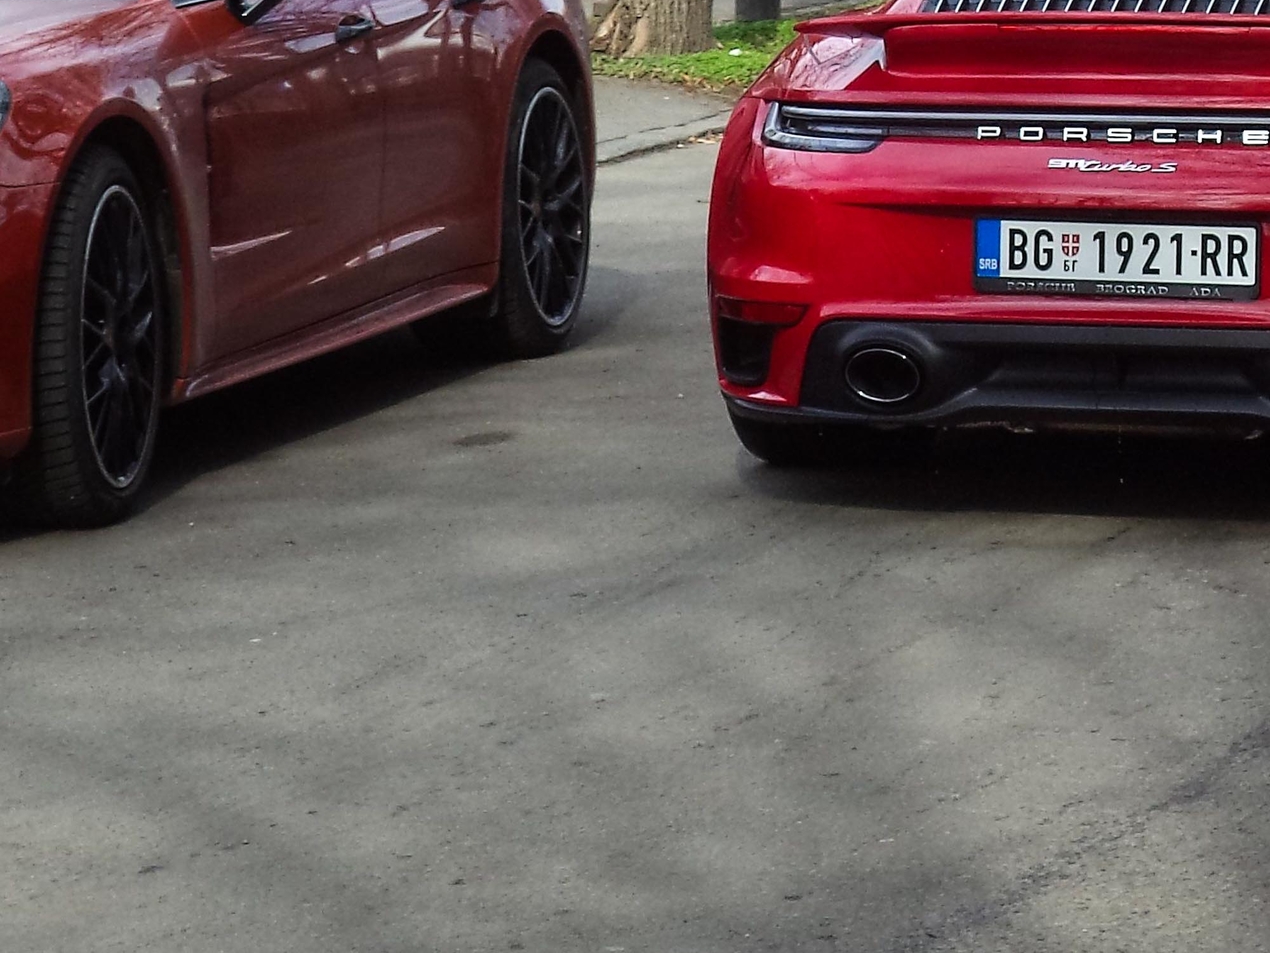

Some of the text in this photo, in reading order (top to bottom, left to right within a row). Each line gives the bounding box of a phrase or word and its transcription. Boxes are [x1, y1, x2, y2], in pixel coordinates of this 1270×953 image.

[976, 125, 1270, 145] PORSCHE
[1151, 162, 1178, 172] S
[1008, 228, 1054, 271] BG
[979, 258, 998, 270] SRB
[1006, 281, 1222, 297] PORSCHE BEOGRAD ADA
